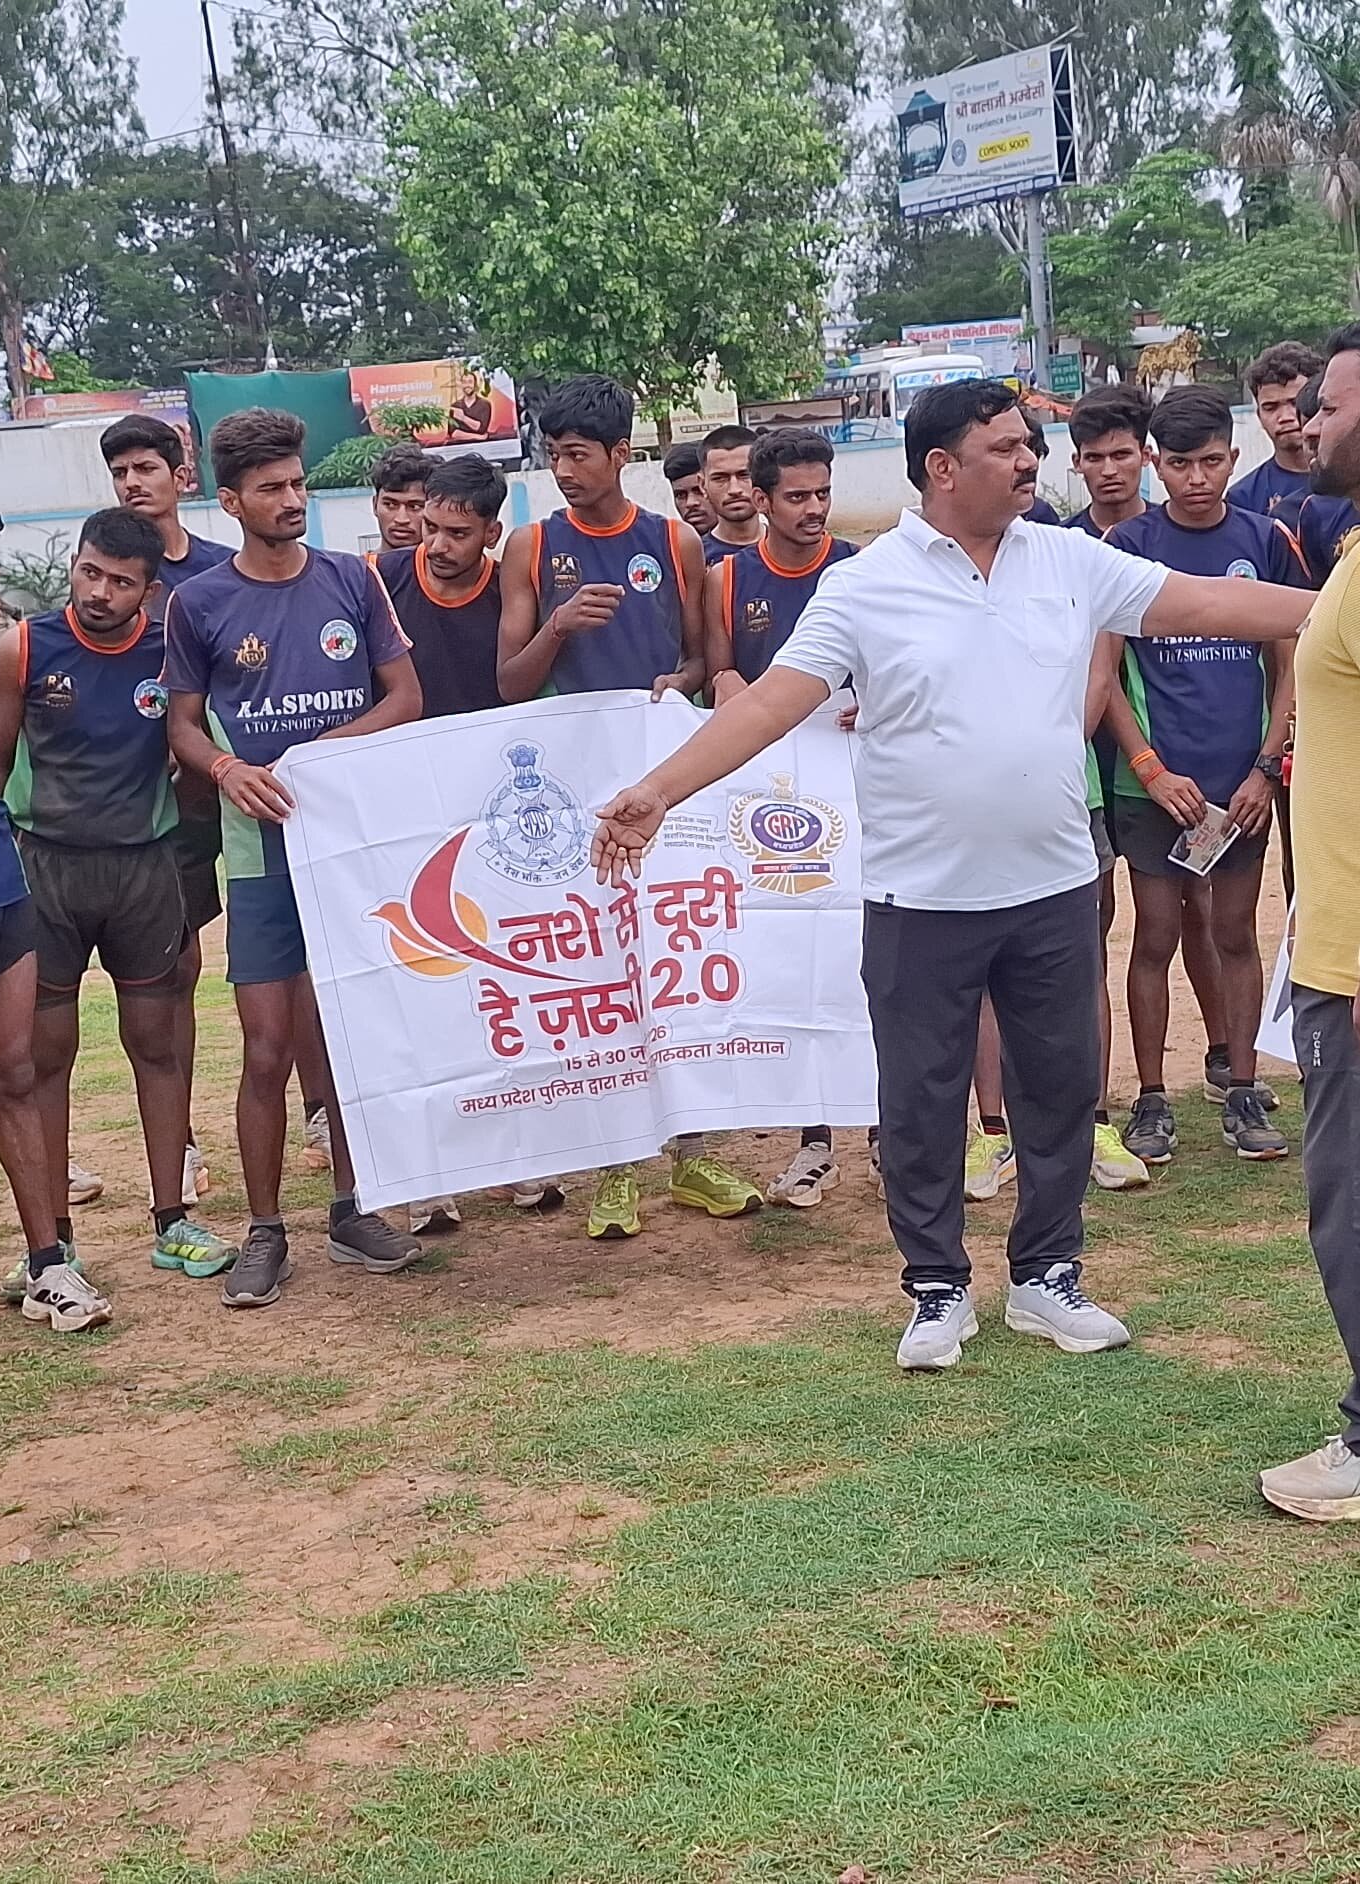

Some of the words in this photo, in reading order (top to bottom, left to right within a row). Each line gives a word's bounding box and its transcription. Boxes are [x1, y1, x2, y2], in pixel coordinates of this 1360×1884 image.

[978, 140, 1007, 158] COMING
[1008, 137, 1030, 150] SOON
[281, 716, 325, 732] SPORTS
[768, 814, 805, 840] GRP
[498, 893, 604, 963] नशे
[648, 866, 743, 952] दूरी
[478, 978, 524, 1057] है
[650, 954, 740, 1009] 2.0
[566, 1056, 582, 1071] 15
[584, 1050, 601, 1068] से
[606, 1049, 626, 1065] 30
[462, 1095, 497, 1114] मध्य
[500, 1087, 536, 1109] प्रदेश
[539, 1079, 585, 1105] पुलिस
[587, 1074, 617, 1095] द्वारा
[716, 1037, 785, 1057] अभियान
